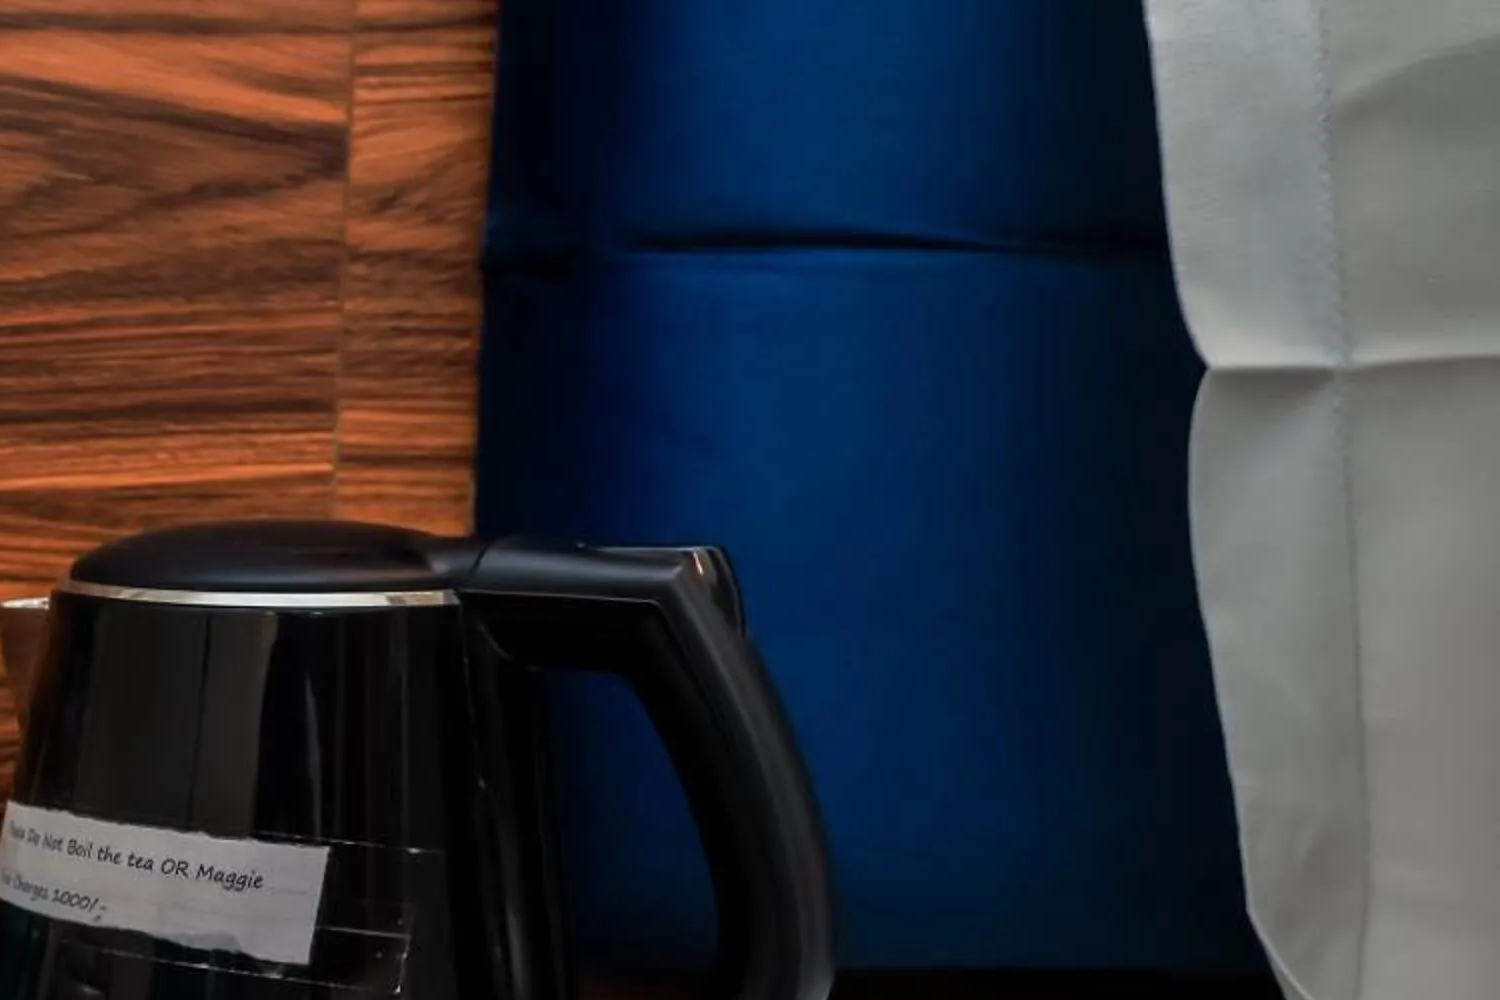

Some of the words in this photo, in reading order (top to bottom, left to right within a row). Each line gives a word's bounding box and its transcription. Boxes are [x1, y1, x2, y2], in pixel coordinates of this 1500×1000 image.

[67, 839, 94, 859] Boil
[97, 846, 121, 865] the
[128, 852, 154, 871] tea
[161, 858, 189, 878] OR
[196, 863, 264, 891] Maggie
